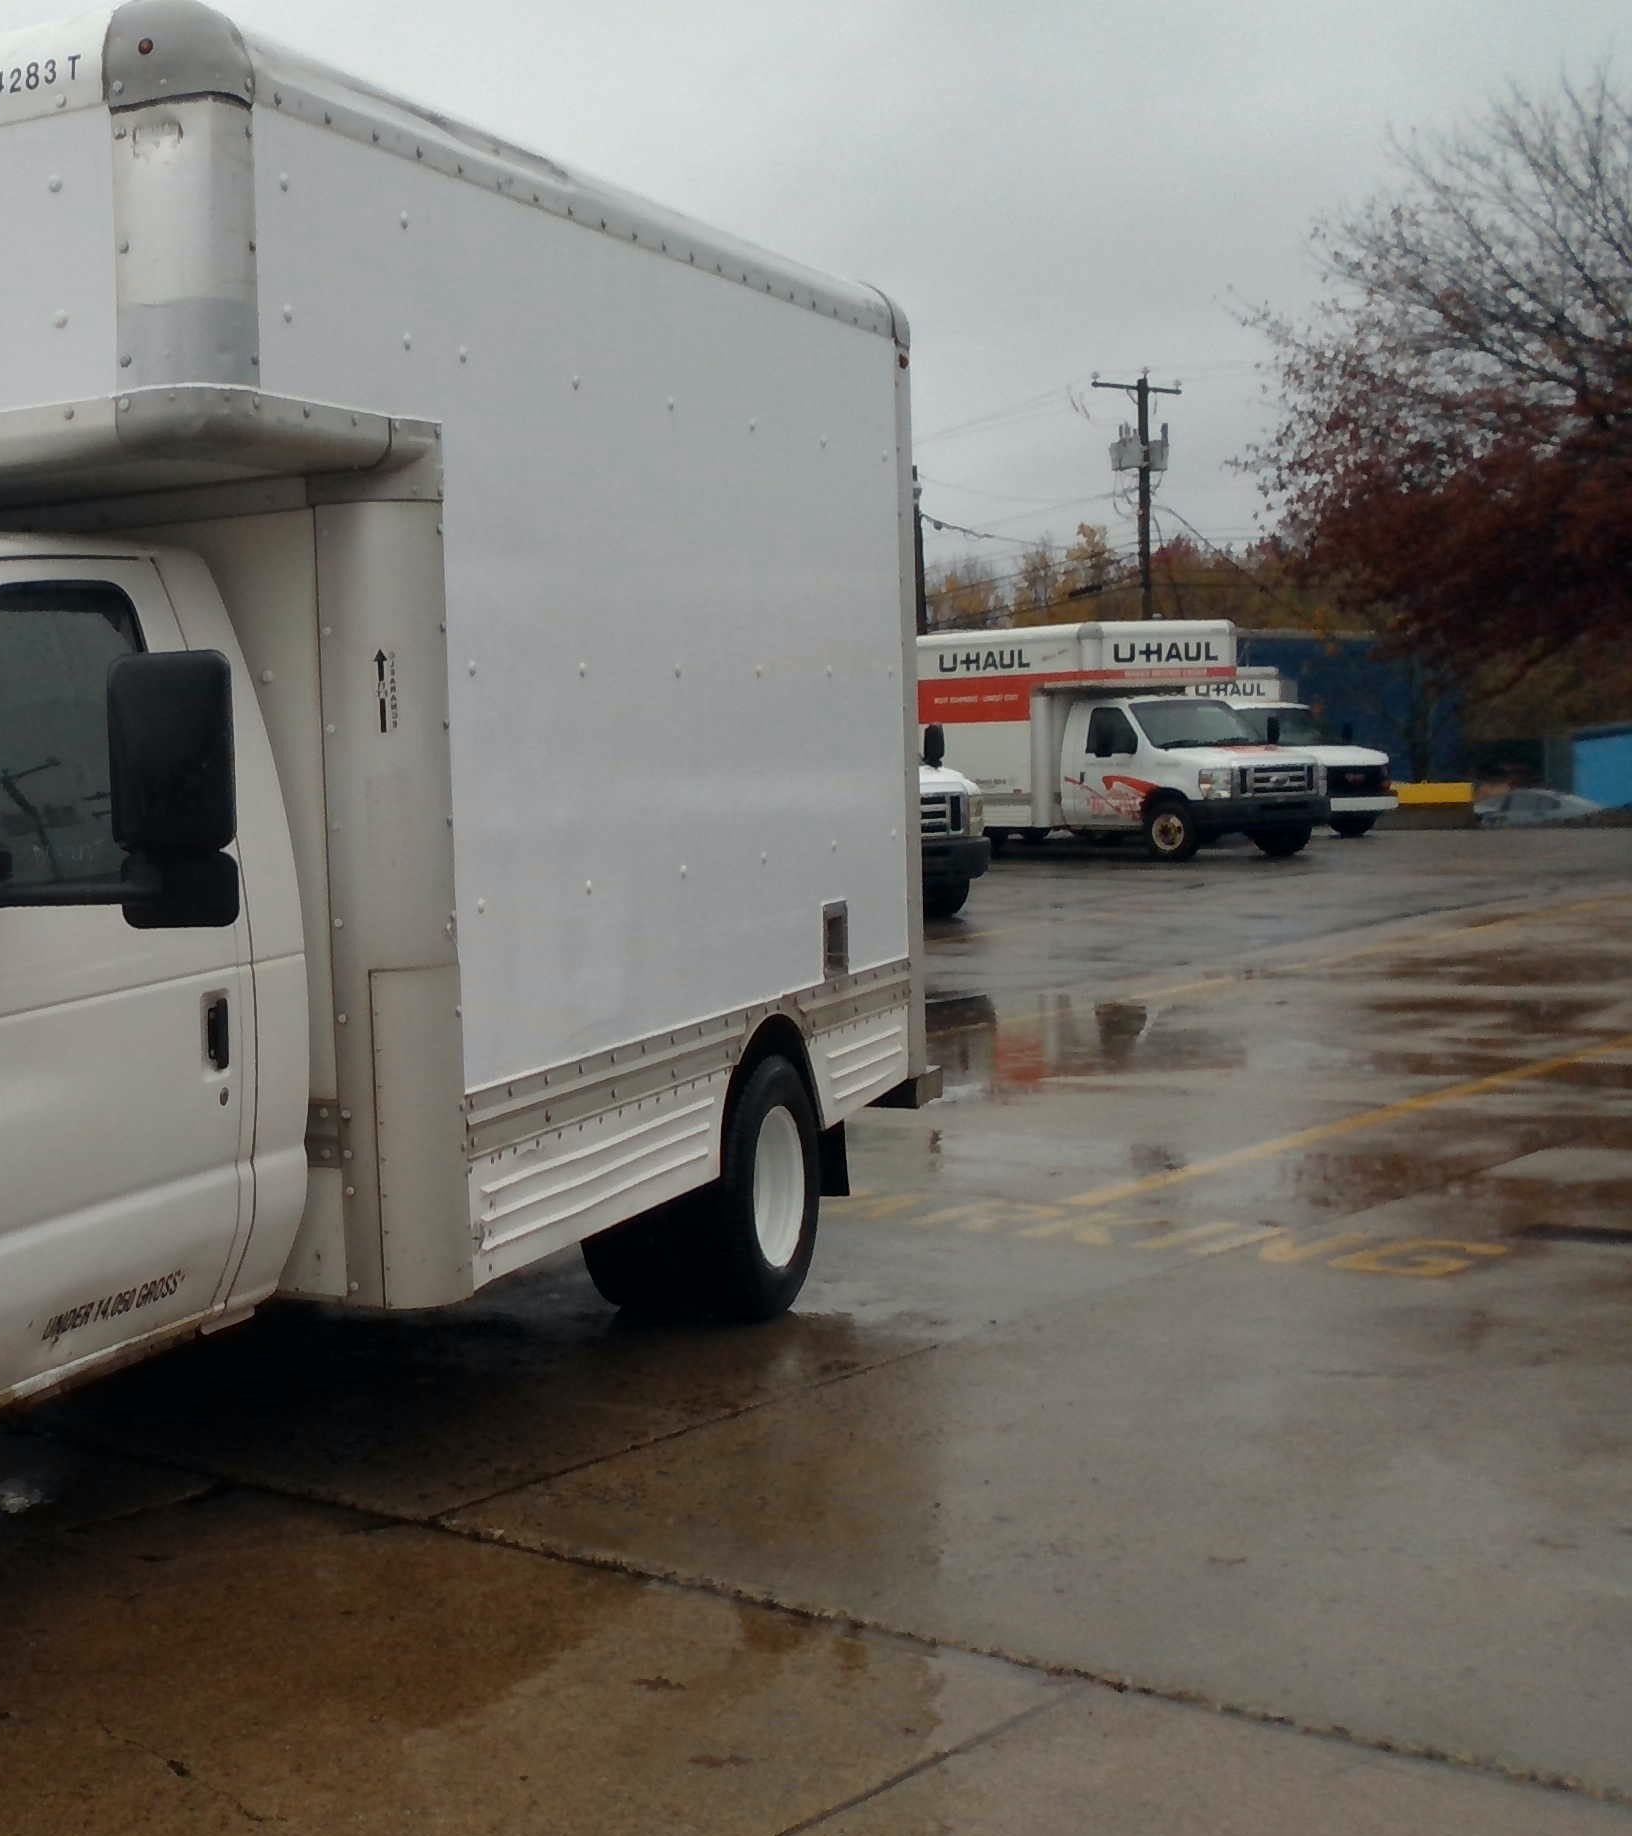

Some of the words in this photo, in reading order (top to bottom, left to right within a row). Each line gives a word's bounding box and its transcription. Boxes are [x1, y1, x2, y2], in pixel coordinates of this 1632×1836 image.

[67, 53, 82, 80] T
[938, 648, 1031, 673] U-HAUL
[1113, 641, 1218, 663] U-HAUL
[1194, 682, 1265, 697] U-HAUL
[41, 1301, 96, 1341] UNDER
